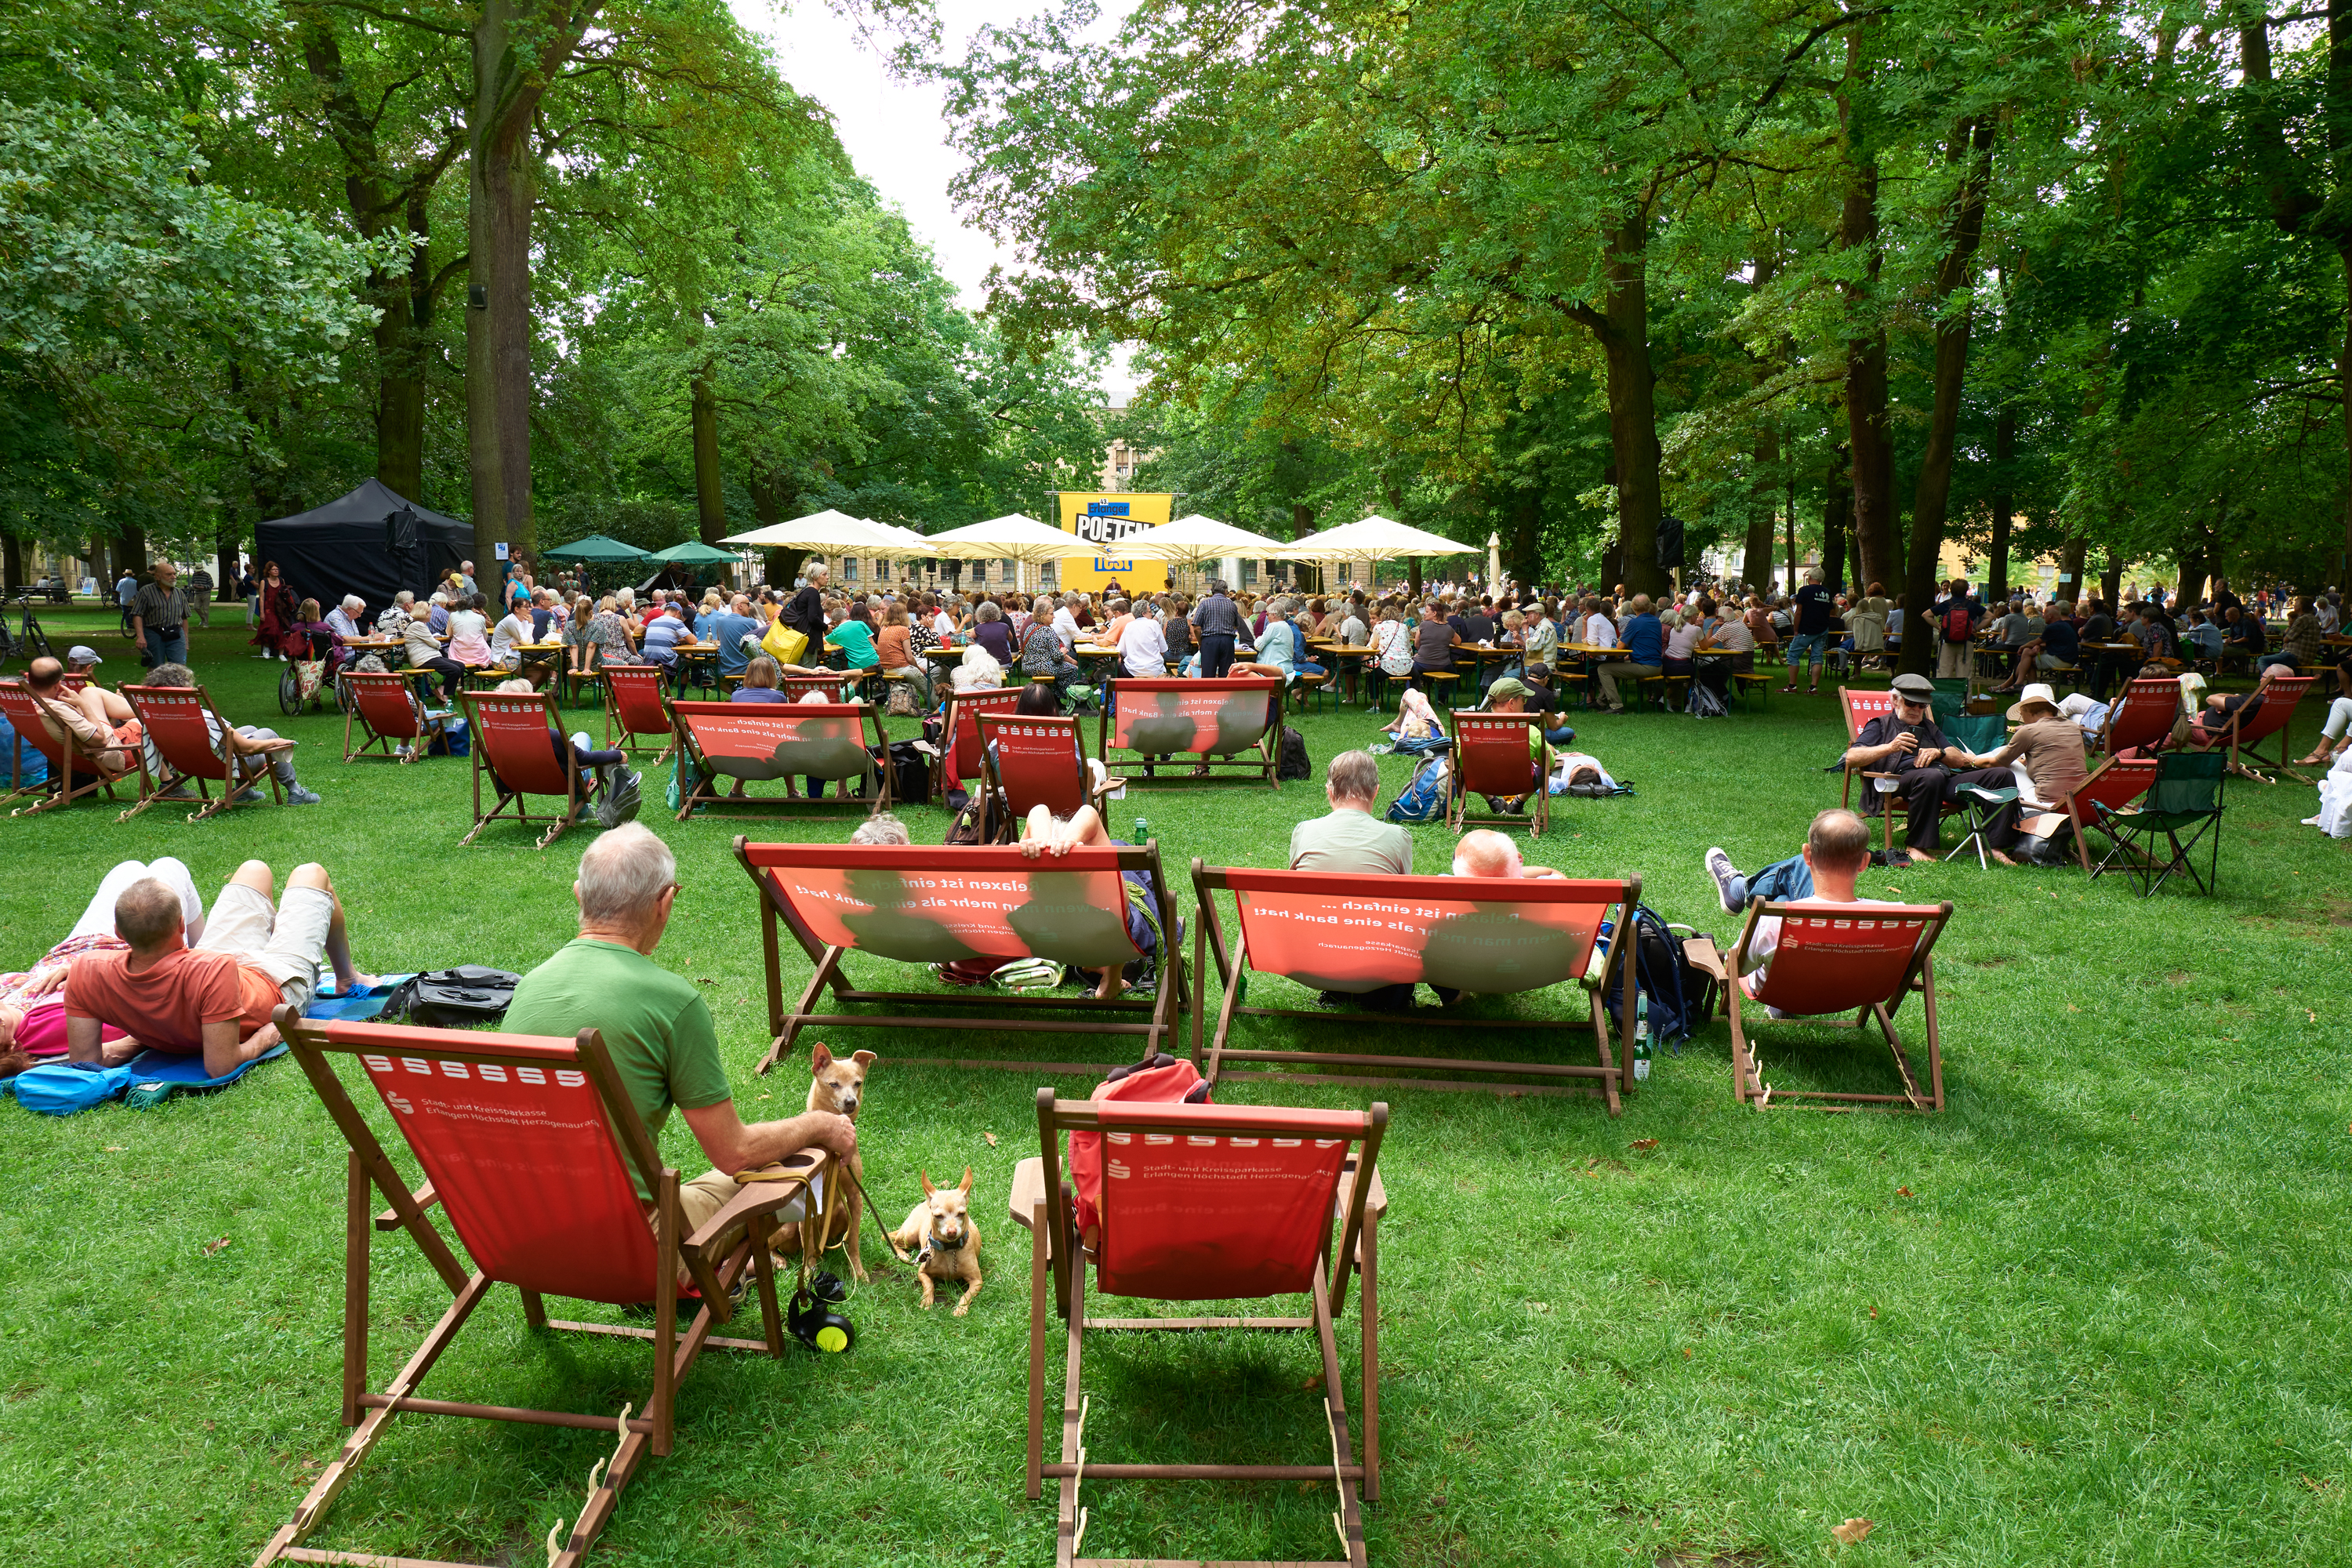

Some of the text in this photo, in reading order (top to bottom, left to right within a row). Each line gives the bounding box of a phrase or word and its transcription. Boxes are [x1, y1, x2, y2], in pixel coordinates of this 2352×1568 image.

[1088, 503, 1128, 515] Erlanger
[420, 1098, 451, 1109] Stadt-
[452, 1102, 473, 1112] und
[474, 1105, 546, 1118] Kreissparkasse
[426, 1107, 470, 1120] Erlangen
[470, 1112, 521, 1126] Höchstadt
